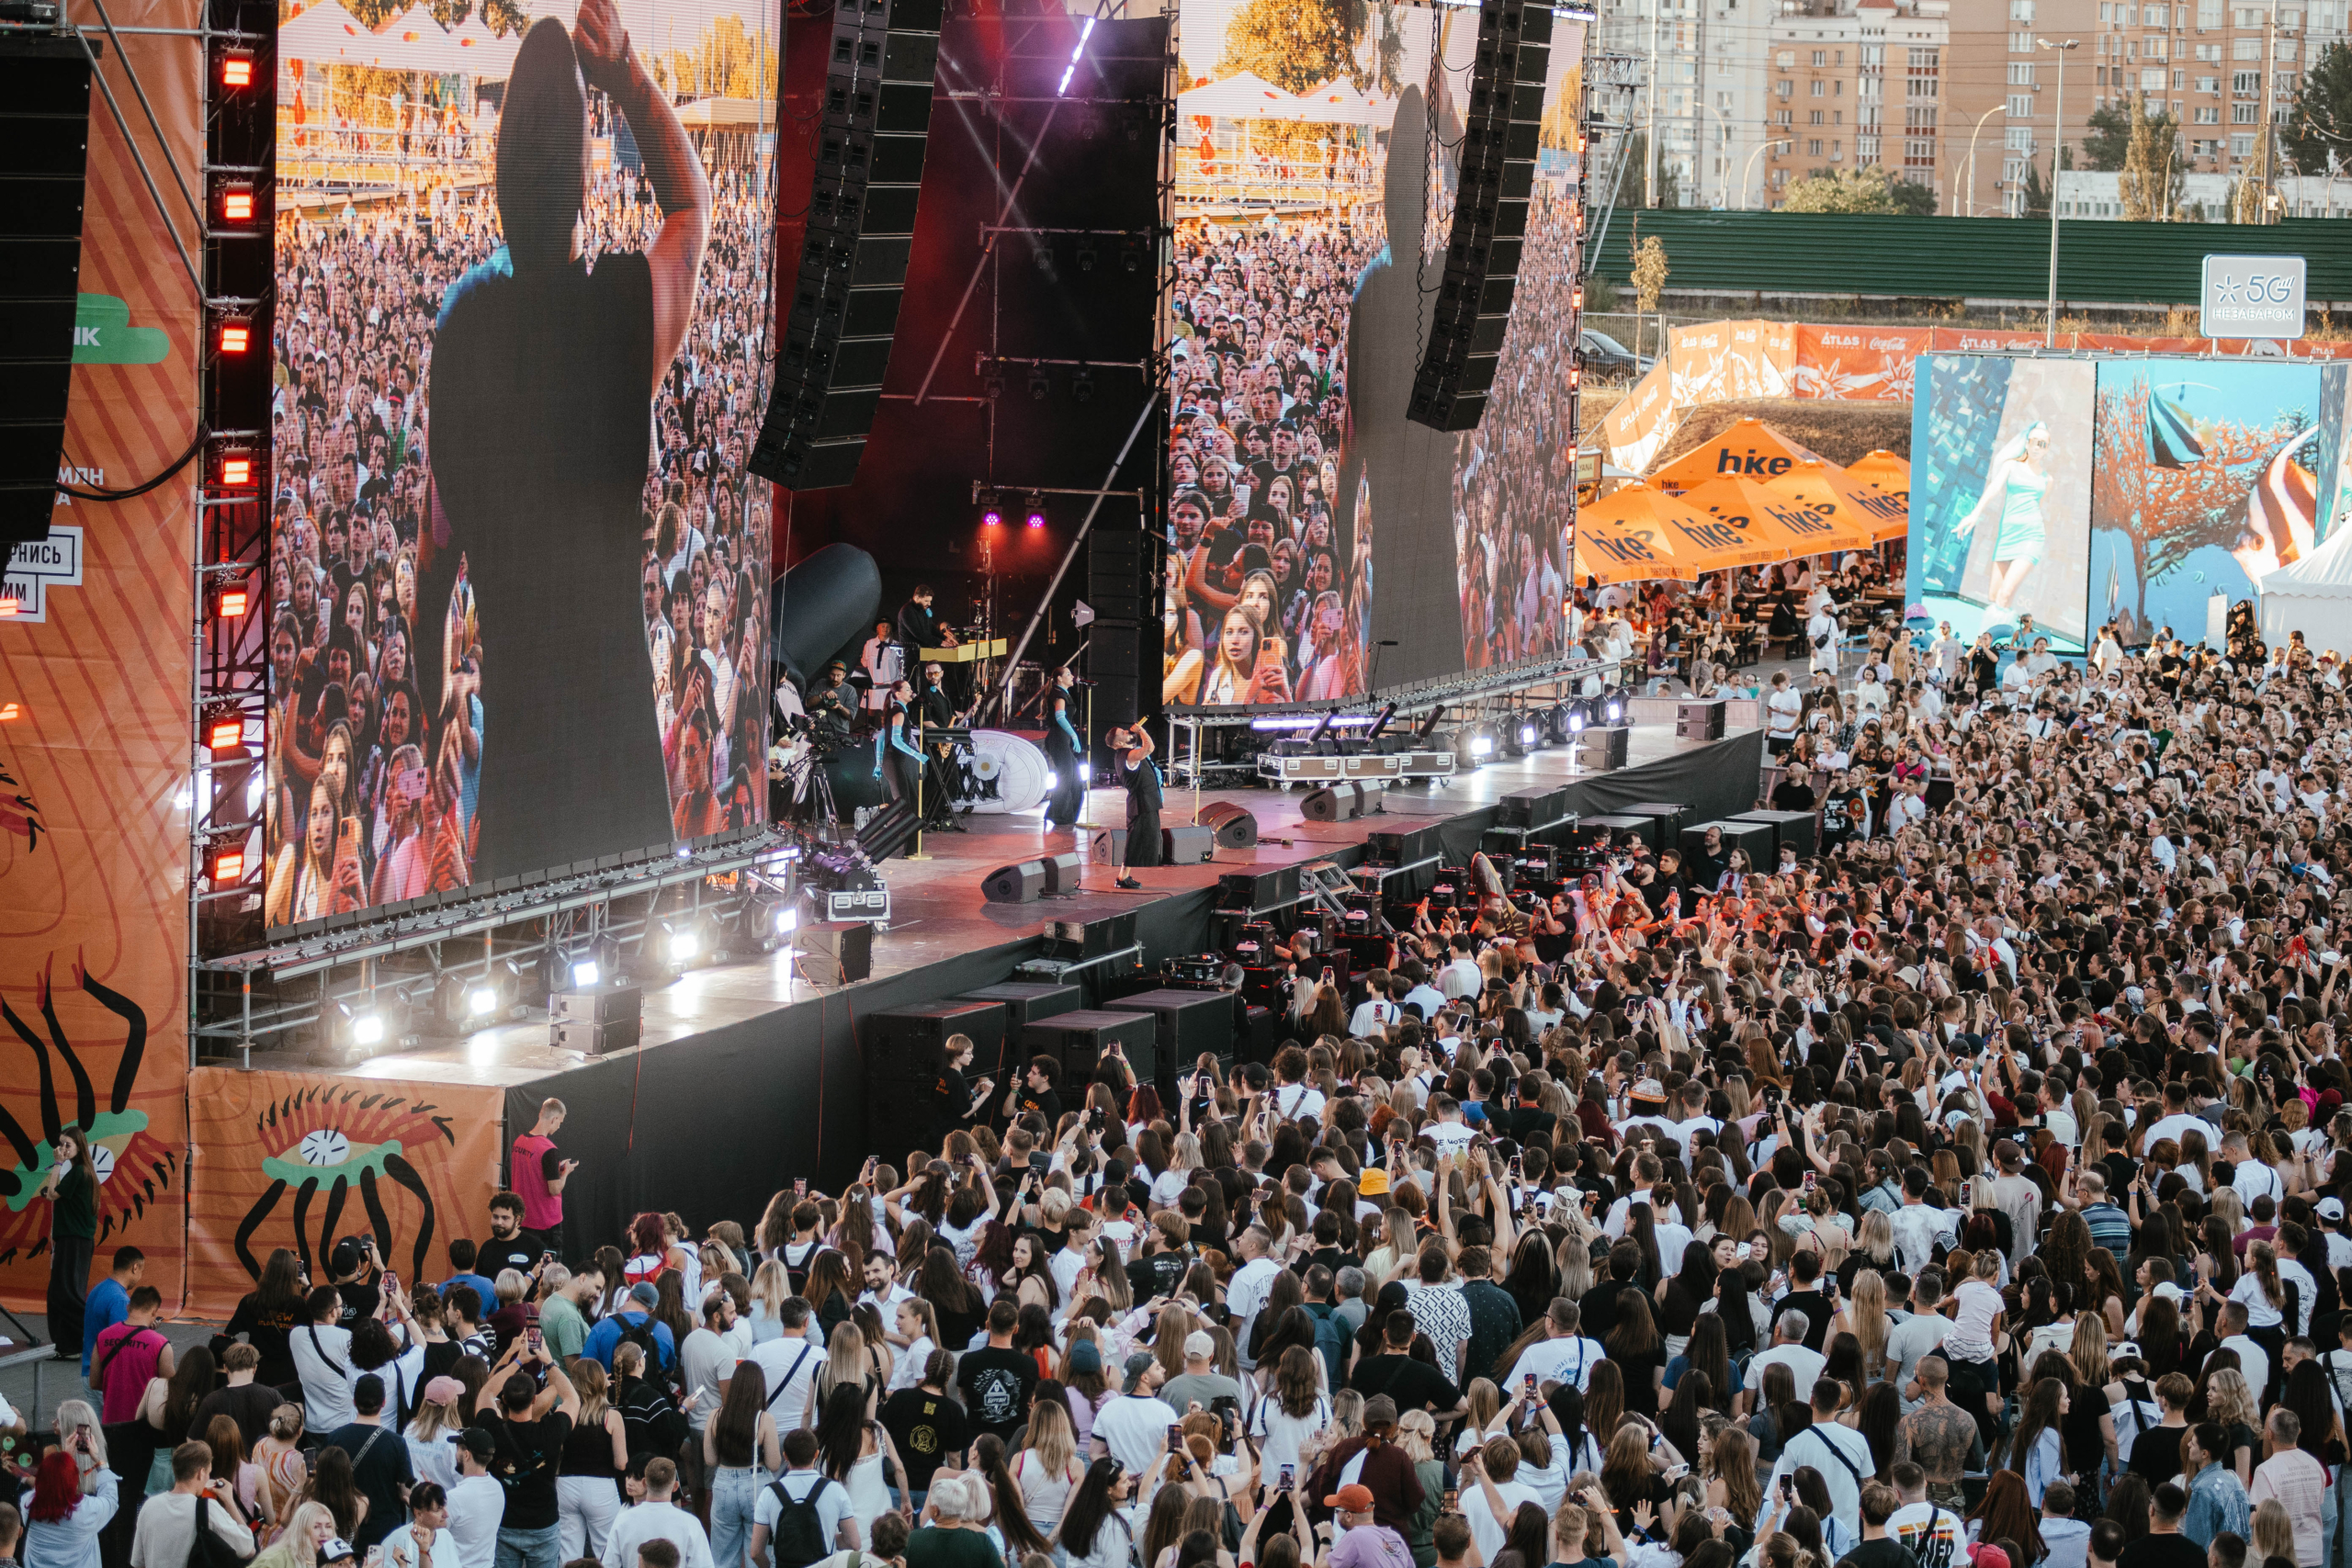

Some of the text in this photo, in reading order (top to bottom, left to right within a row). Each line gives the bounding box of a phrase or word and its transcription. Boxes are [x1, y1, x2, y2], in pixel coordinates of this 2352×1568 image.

[2246, 276, 2295, 303] 5G
[2212, 308, 2295, 321] НЕЗАБАРОМ
[1717, 448, 1792, 476] hike
[1661, 479, 1679, 490] hike
[1847, 490, 1909, 520] hike
[1671, 517, 1744, 549] hike
[1764, 504, 1833, 535] hike
[10, 545, 62, 564] РНИСЬ
[1581, 530, 1655, 562] hike
[104, 1337, 150, 1350] SECRITY
[1551, 1359, 1568, 1379] ADIDAS
